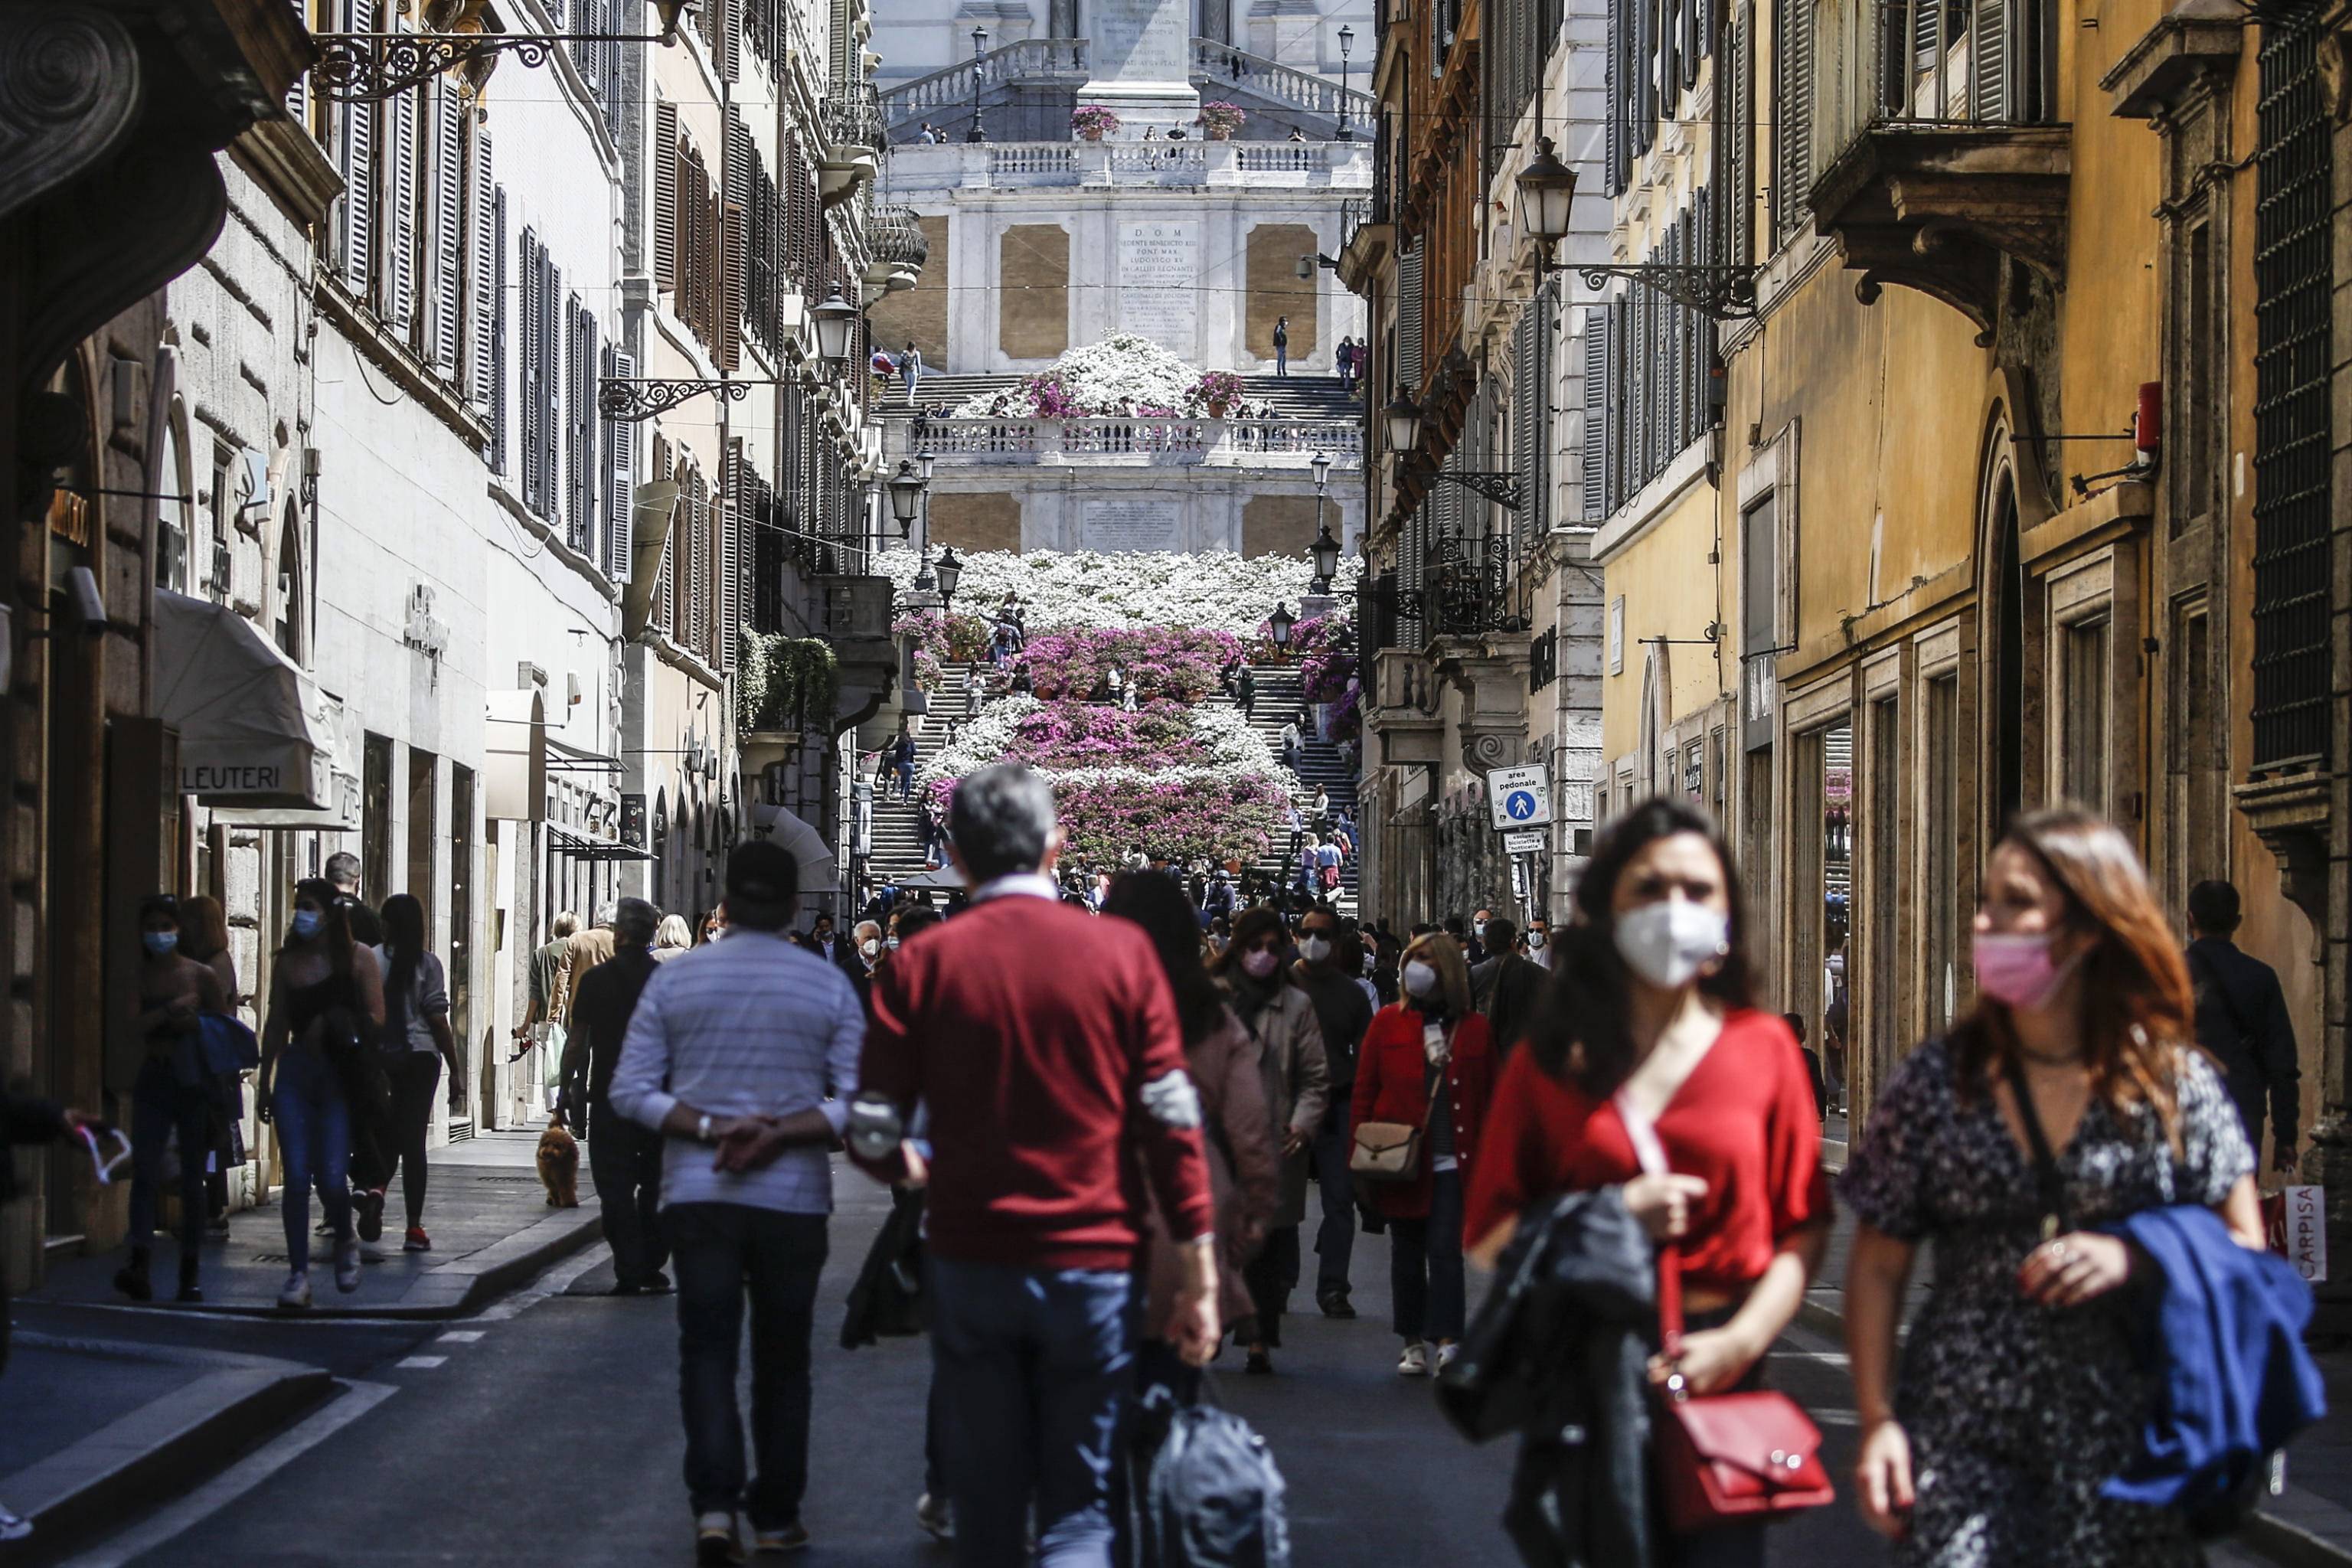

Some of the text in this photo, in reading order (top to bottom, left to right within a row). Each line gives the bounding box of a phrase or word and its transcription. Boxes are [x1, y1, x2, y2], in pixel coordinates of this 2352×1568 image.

[178, 766, 279, 789] LEUTERI
[1499, 779, 1537, 790] pedonale
[2297, 1187, 2316, 1279] CARPISA
